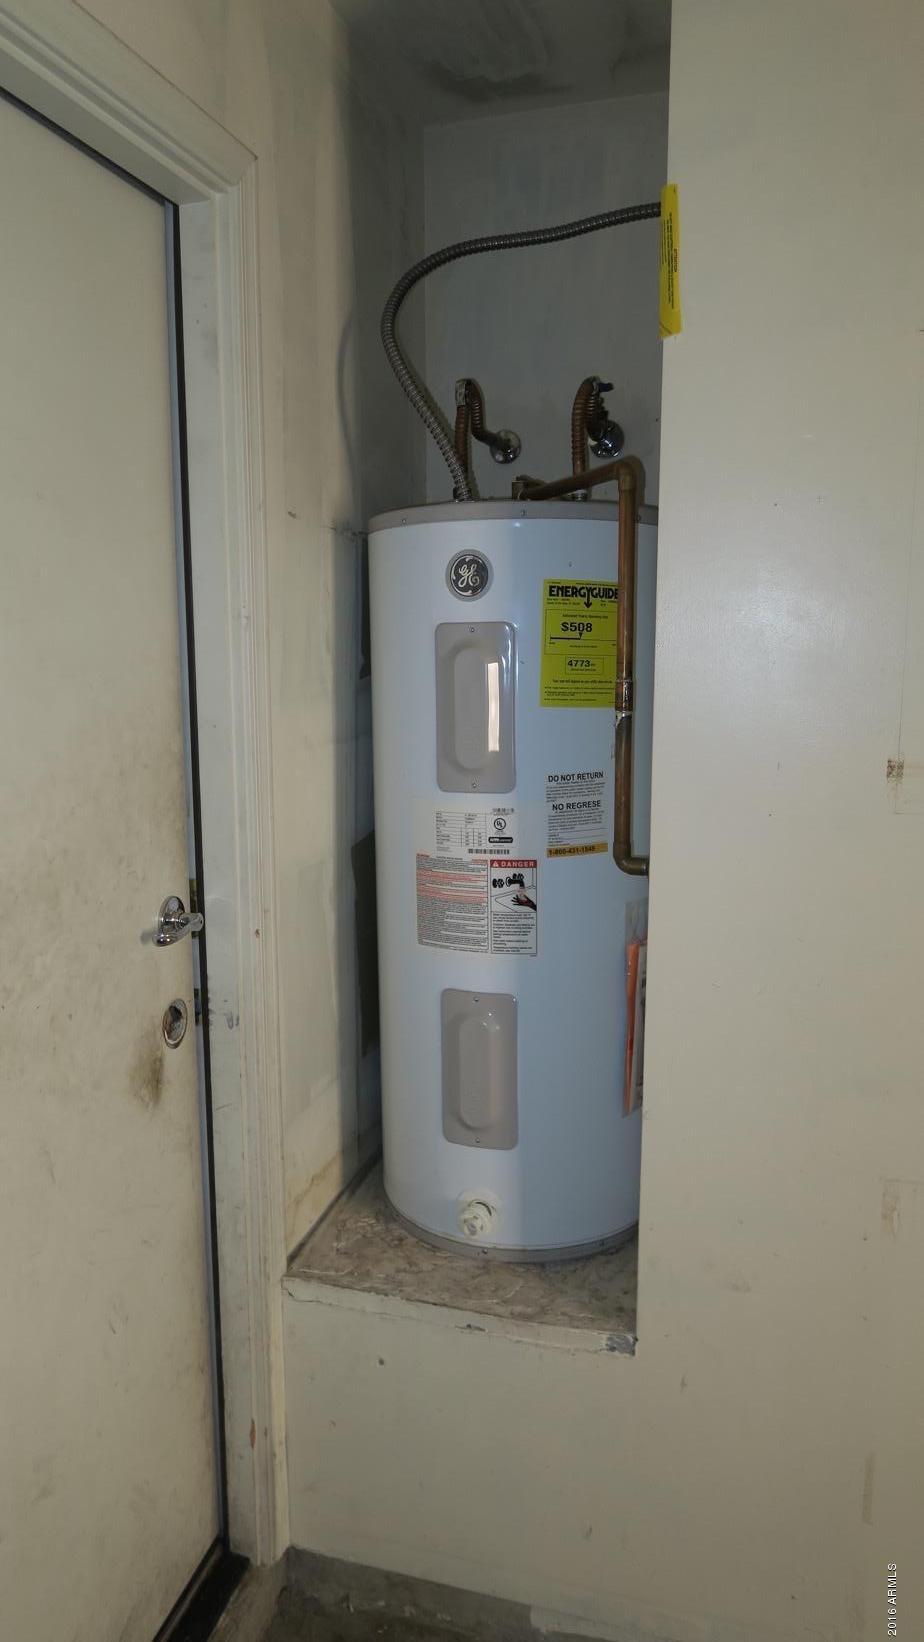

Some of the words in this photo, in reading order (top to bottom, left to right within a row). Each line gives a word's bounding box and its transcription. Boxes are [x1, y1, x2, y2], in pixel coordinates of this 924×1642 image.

[458, 564, 480, 588] GE
[560, 621, 593, 633] $508
[567, 659, 591, 668] 4773
[548, 775, 560, 783] DO
[561, 773, 575, 782] NOT
[577, 771, 604, 780] RETURN
[552, 803, 564, 811] NO
[566, 800, 601, 810] REGRESE
